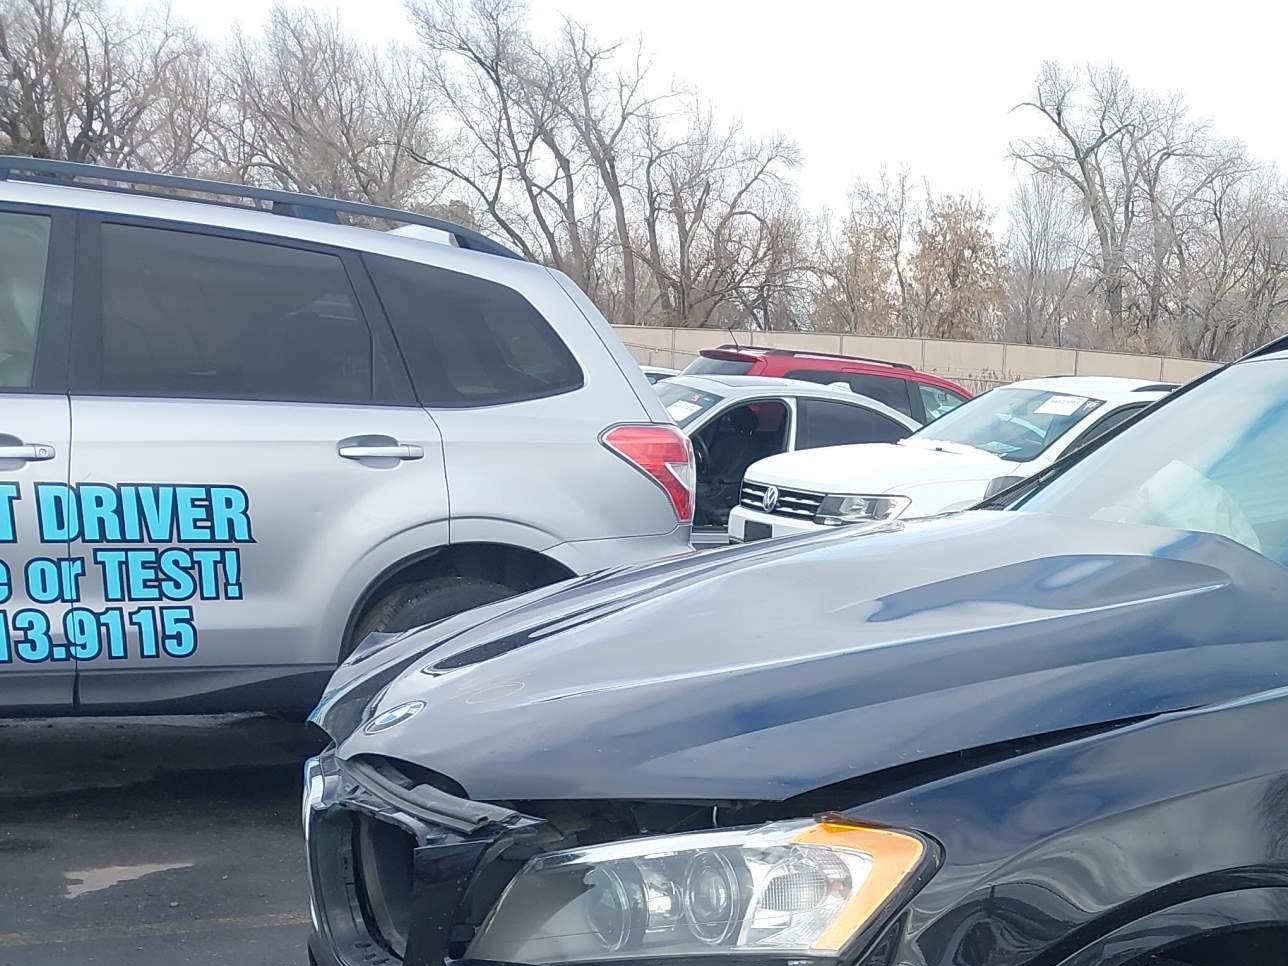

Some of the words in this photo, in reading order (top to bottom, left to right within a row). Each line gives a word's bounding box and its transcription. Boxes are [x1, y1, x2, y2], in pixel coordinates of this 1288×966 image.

[34, 481, 257, 543] DRIVER
[24, 557, 85, 603] or
[93, 548, 243, 601] TEST!
